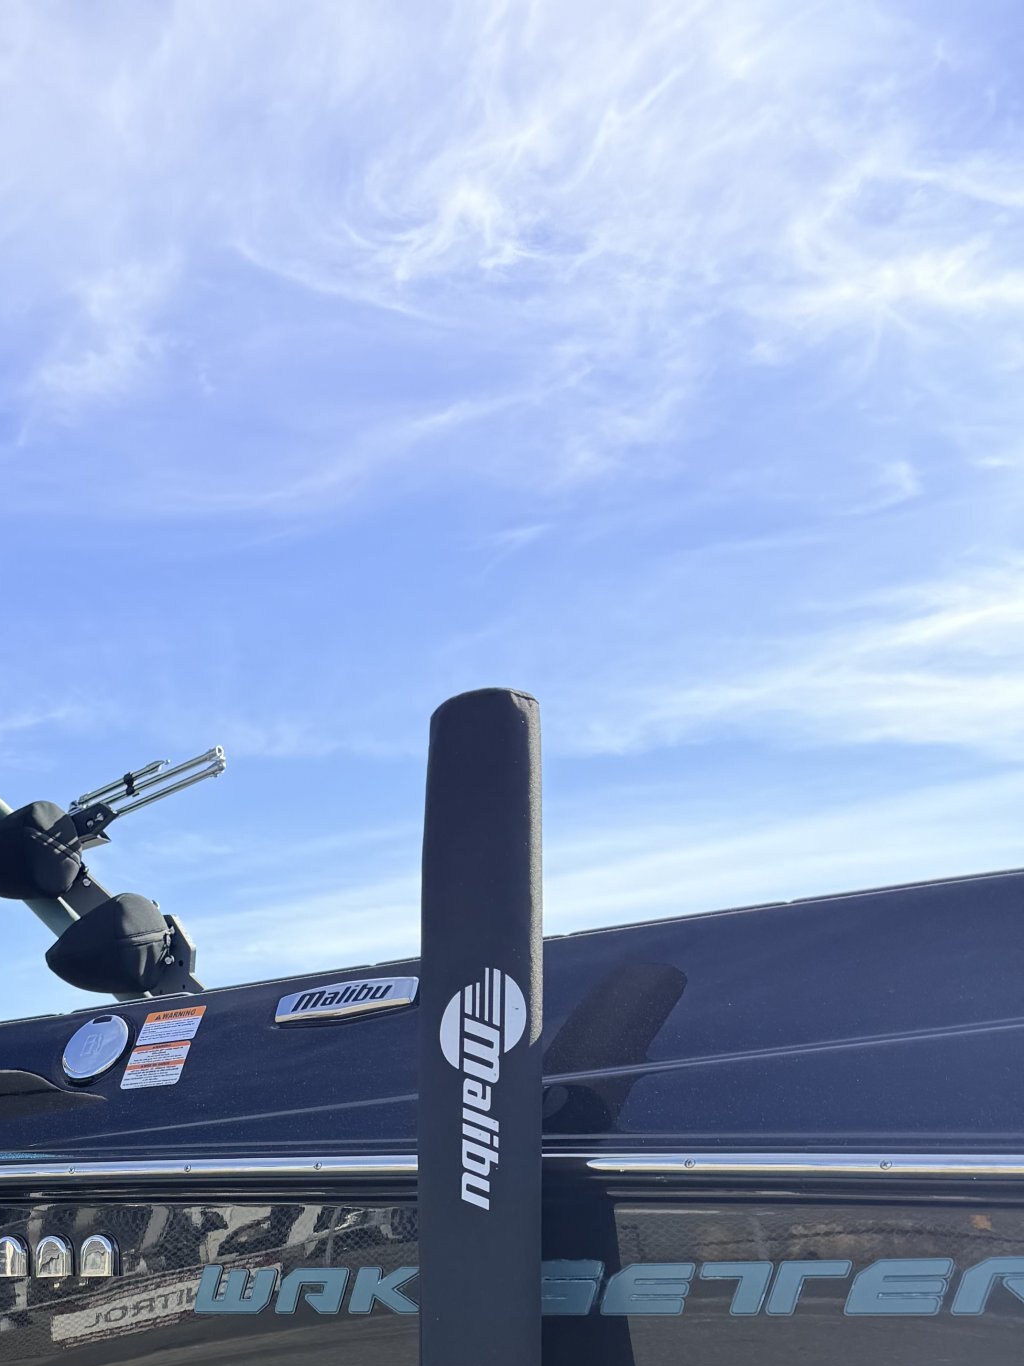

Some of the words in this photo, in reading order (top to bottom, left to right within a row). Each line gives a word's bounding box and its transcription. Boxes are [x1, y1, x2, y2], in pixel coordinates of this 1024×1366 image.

[162, 1009, 196, 1020] WARNING
[291, 983, 393, 1012] Malibu
[461, 1017, 500, 1211] Malibu
[194, 1256, 1024, 1317] WAKSETTER
